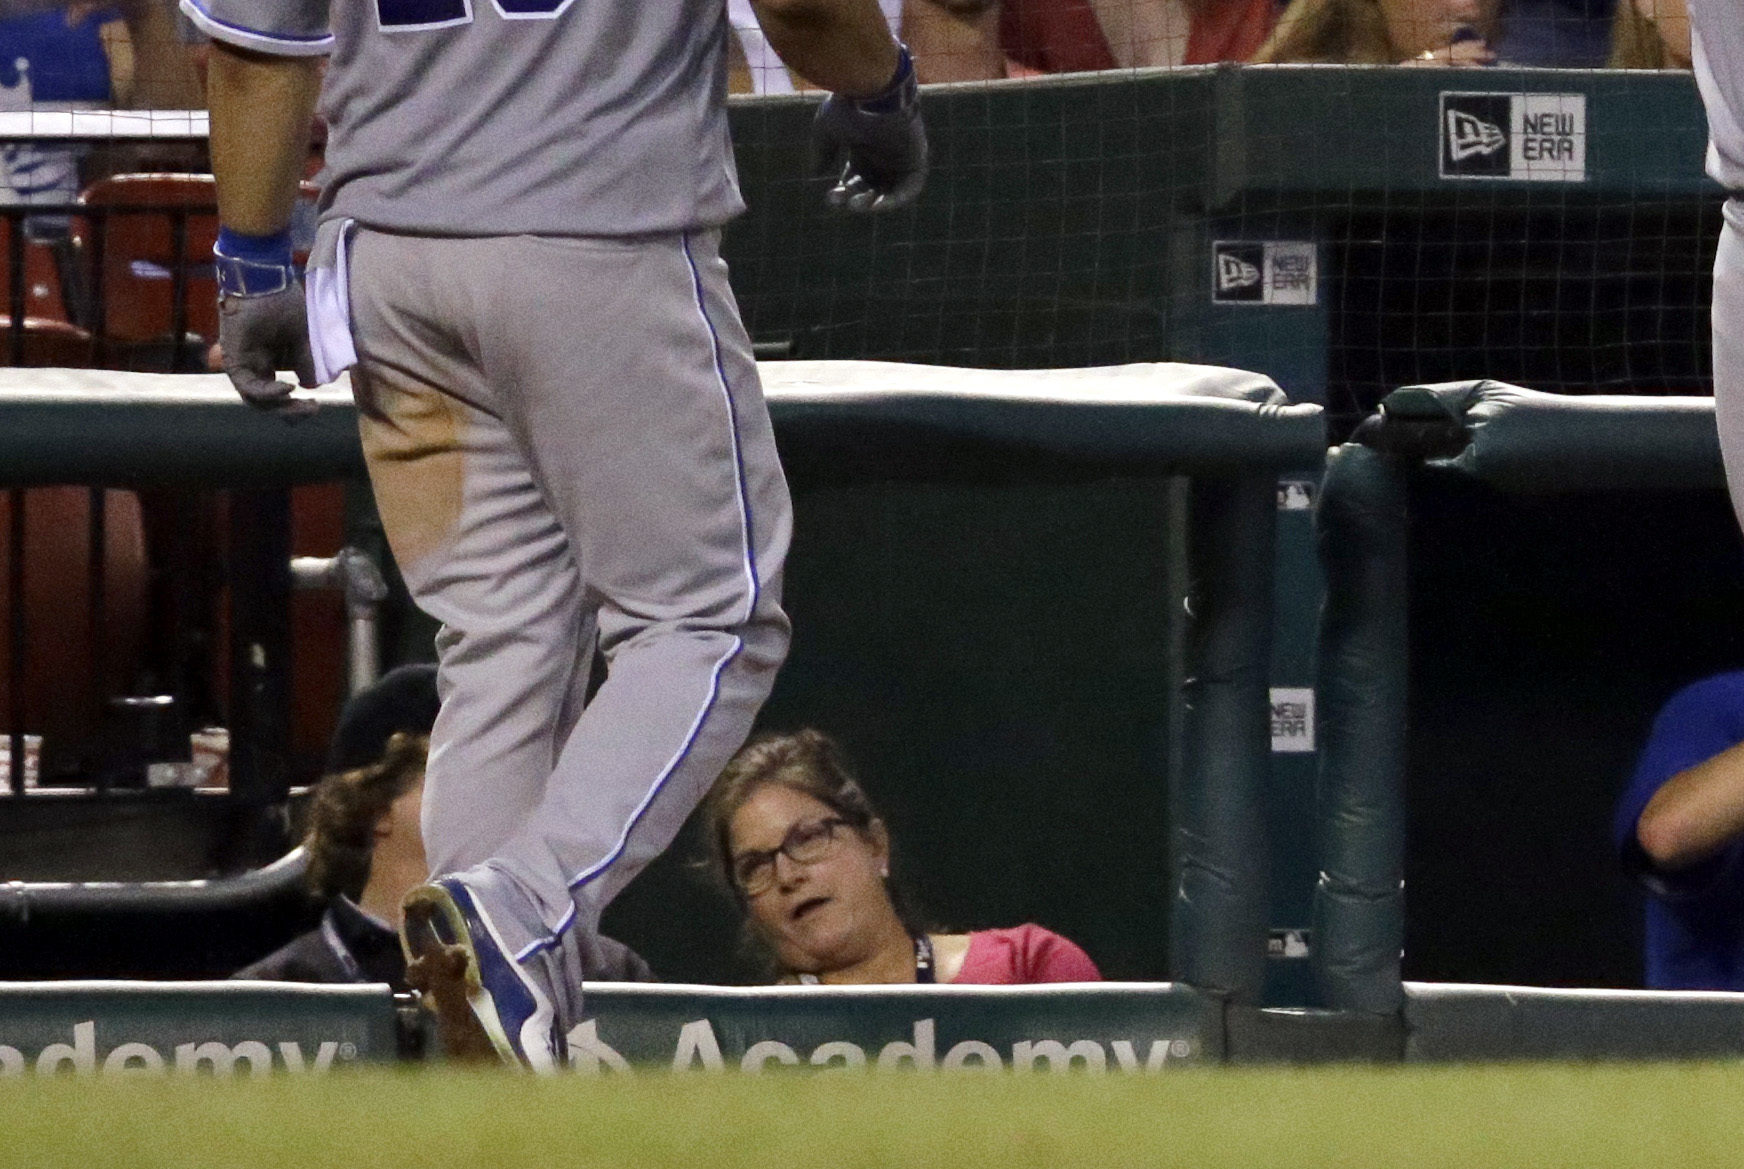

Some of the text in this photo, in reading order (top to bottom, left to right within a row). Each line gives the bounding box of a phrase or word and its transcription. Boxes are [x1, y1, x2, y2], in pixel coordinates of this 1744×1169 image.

[1522, 112, 1575, 136] NEW
[1522, 137, 1575, 161] ERA
[1272, 255, 1310, 272] NEW
[1272, 272, 1310, 290] ERA
